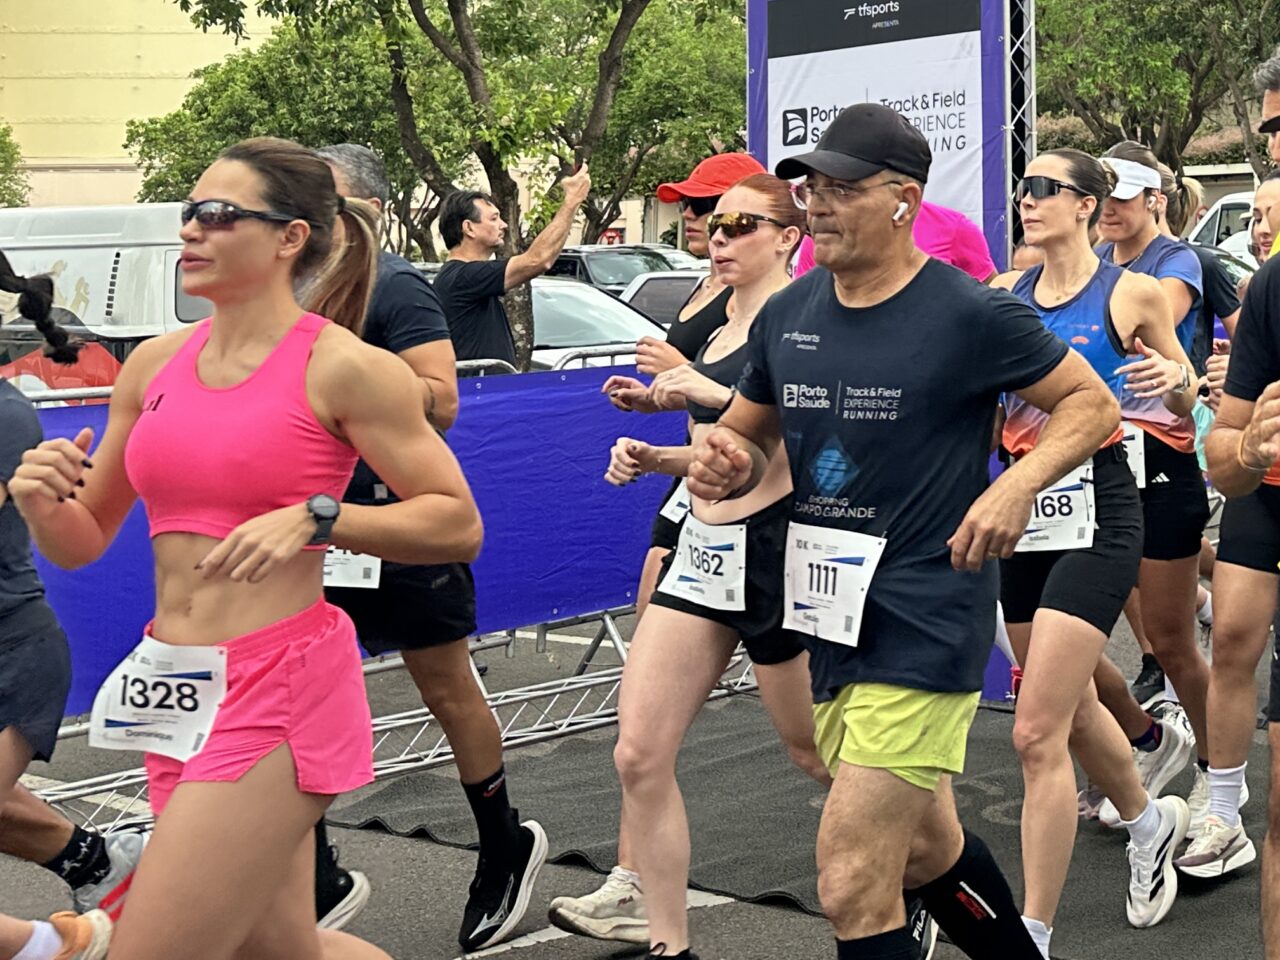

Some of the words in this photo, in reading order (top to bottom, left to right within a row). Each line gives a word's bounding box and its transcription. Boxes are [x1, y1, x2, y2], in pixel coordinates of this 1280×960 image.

[858, 0, 900, 18] tfsports
[880, 95, 919, 113] Track
[920, 94, 930, 110] &
[932, 89, 966, 108] Field
[908, 112, 966, 132] RIENCE
[799, 384, 827, 397] Porto
[877, 388, 902, 398] Field
[799, 396, 831, 408] Saúde
[844, 398, 899, 409] EXPERIENCE
[843, 410, 897, 420] RUNNING
[823, 507, 876, 518] GRANDE
[1034, 494, 1073, 519] 168
[688, 544, 724, 577] 1362
[808, 562, 838, 596] 1111
[121, 674, 199, 712] 1328
[912, 909, 926, 942] FILA
